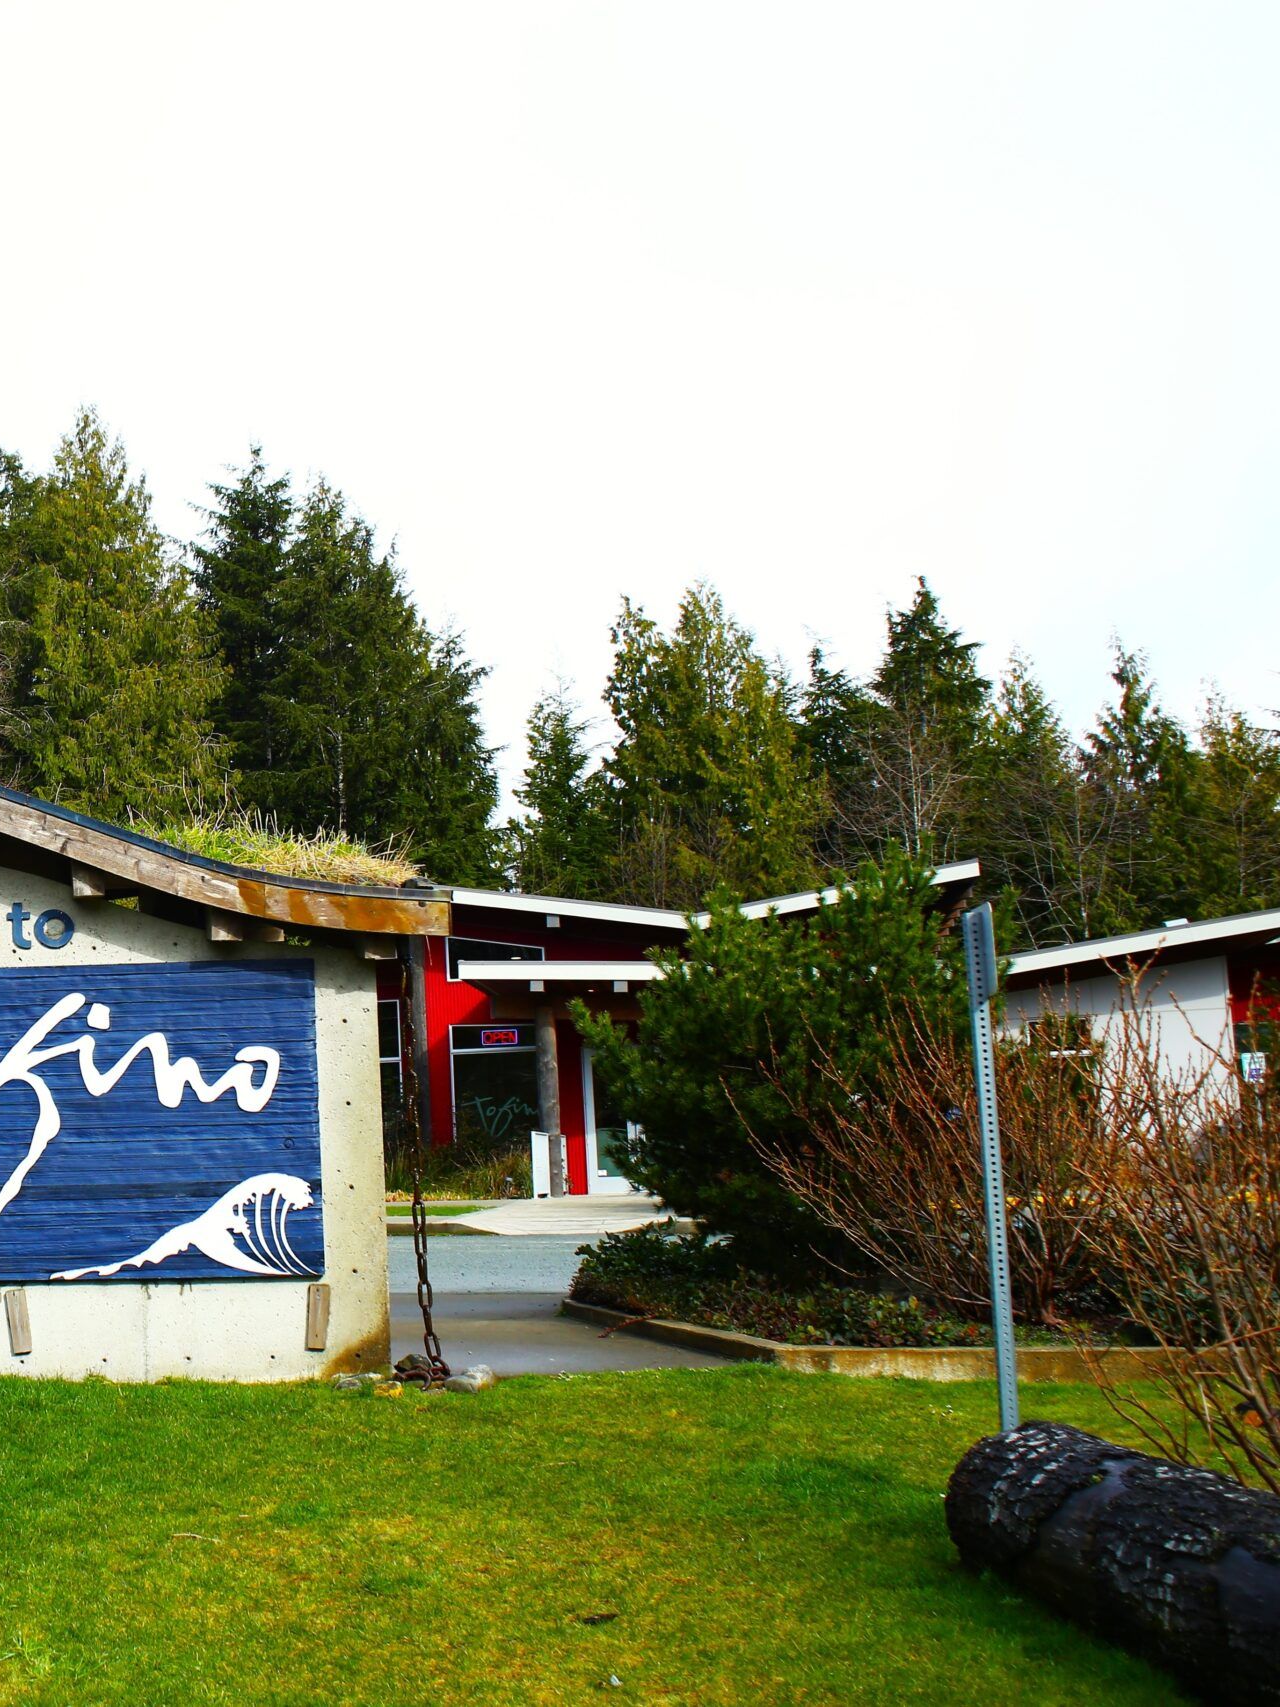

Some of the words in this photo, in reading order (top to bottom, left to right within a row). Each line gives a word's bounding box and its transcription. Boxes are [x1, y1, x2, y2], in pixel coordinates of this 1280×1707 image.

[6, 902, 75, 949] to
[484, 1031, 515, 1044] OPEN
[461, 1096, 538, 1137] Tofin
